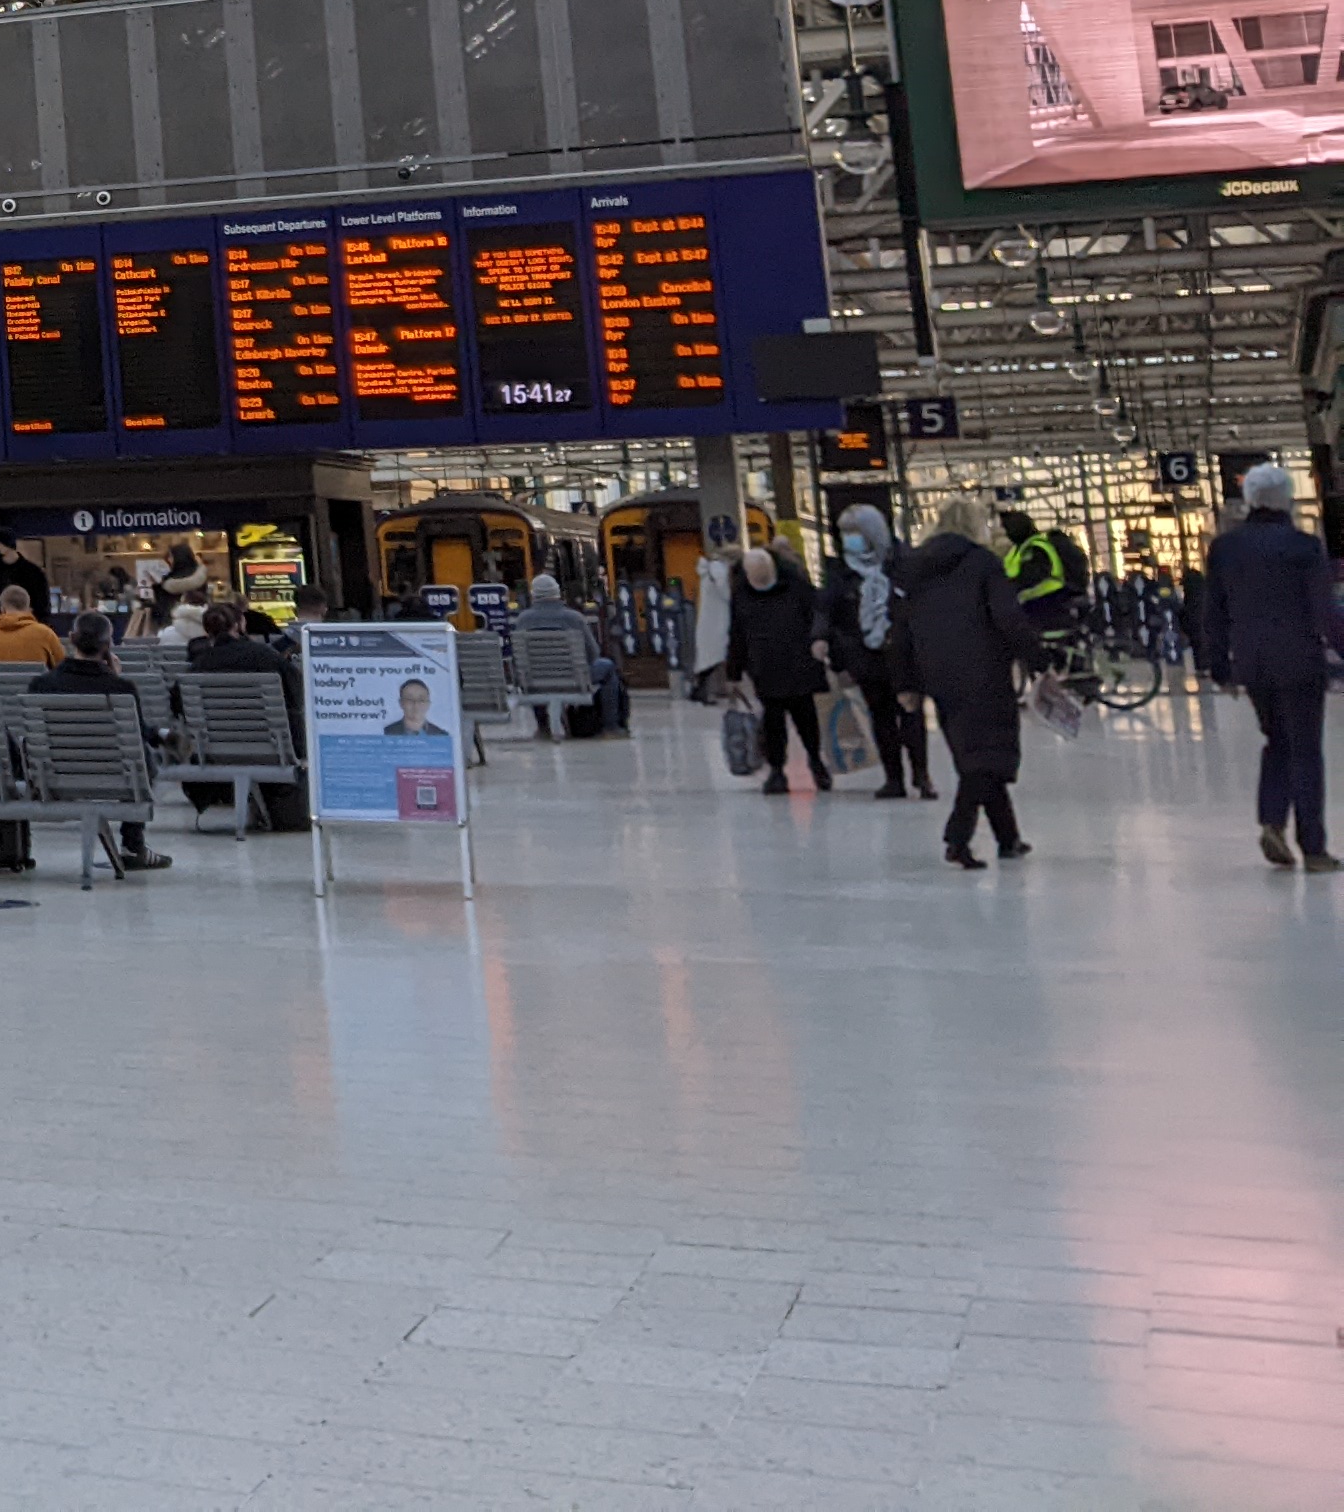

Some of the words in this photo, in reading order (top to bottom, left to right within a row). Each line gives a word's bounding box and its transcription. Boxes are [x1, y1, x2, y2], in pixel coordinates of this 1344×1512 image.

[1222, 179, 1298, 196] JCDecaux
[591, 196, 628, 208] Arrivals
[464, 205, 517, 217] Information
[341, 216, 369, 226] Lower
[371, 213, 396, 224] Level
[398, 211, 441, 222] Platforms
[224, 223, 276, 235] Subsequent
[277, 220, 326, 231] Departures
[392, 238, 434, 249] Platform
[347, 253, 386, 264] Larkhall
[115, 270, 156, 280] Cathcart
[662, 280, 712, 293] Cancelled
[231, 291, 253, 301] East
[602, 299, 640, 308] London
[642, 296, 680, 307] Euston
[400, 330, 442, 340] Platform
[236, 349, 282, 360] Edinburgh
[501, 382, 553, 404] 15:41
[555, 390, 571, 401] 27
[921, 404, 945, 433] 5
[1169, 457, 1188, 481] 6
[101, 509, 201, 527] Information
[313, 664, 352, 674] Where
[379, 667, 402, 676] you
[405, 664, 421, 674] off
[424, 666, 435, 674] to
[314, 678, 355, 690] today?
[315, 696, 343, 706] How
[347, 696, 385, 706] about
[316, 710, 387, 719] tomorrow?
